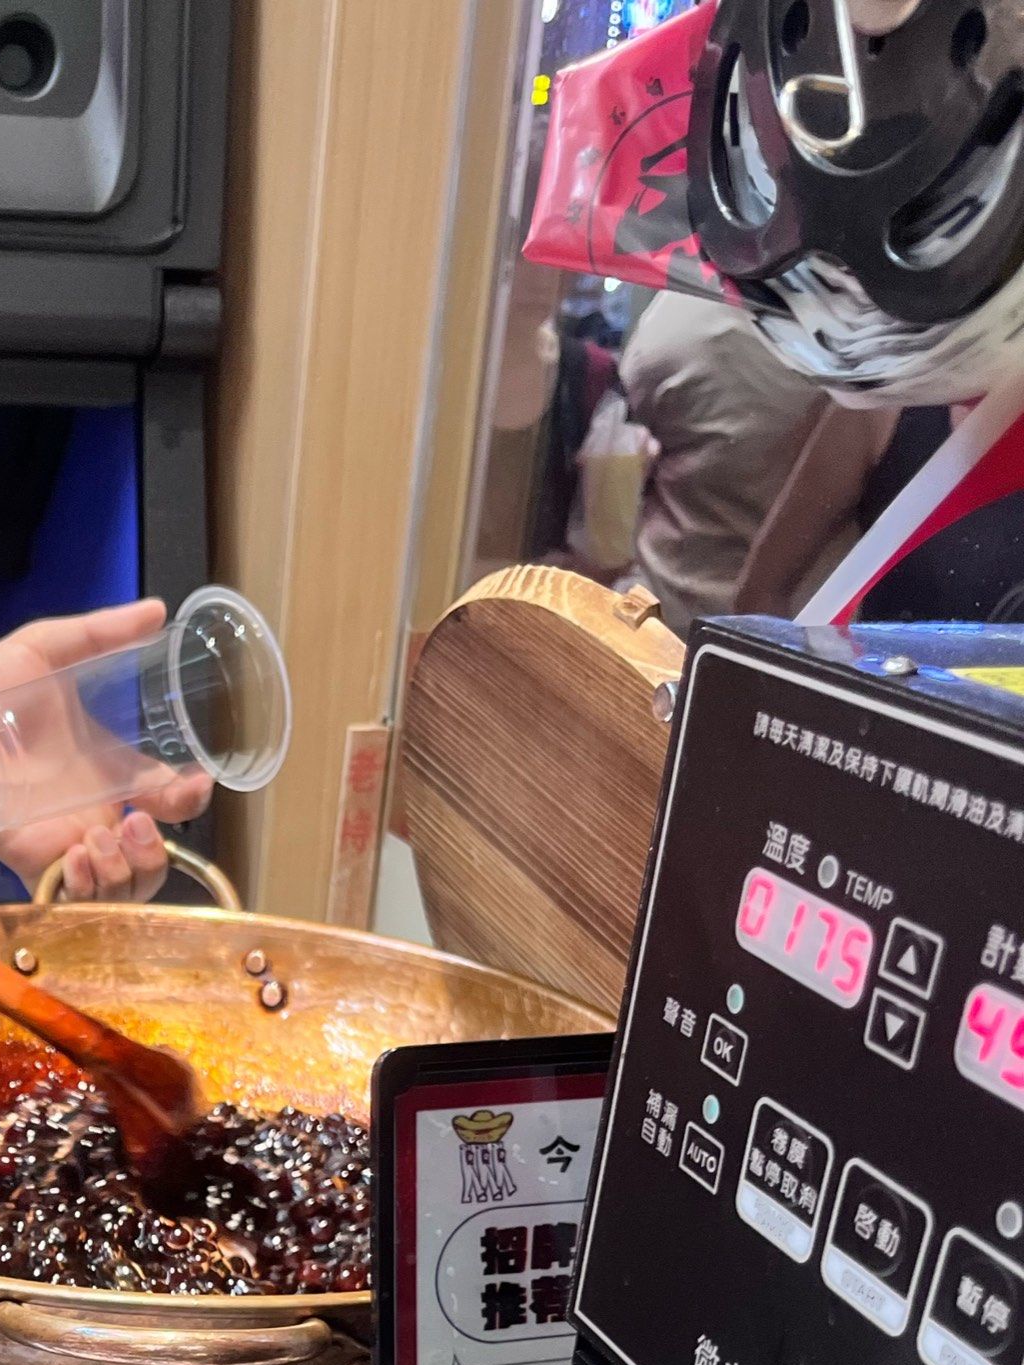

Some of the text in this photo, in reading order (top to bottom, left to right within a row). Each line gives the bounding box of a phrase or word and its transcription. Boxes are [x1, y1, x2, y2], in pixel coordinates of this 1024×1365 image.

[762, 821, 895, 910] 溫度 TEMP
[739, 875, 869, 993] 0175
[713, 1035, 734, 1063] OK
[539, 1136, 580, 1173] 今
[640, 1118, 673, 1157] 自動
[686, 1142, 717, 1173] AUTO
[955, 1275, 1011, 1334] 暫停
